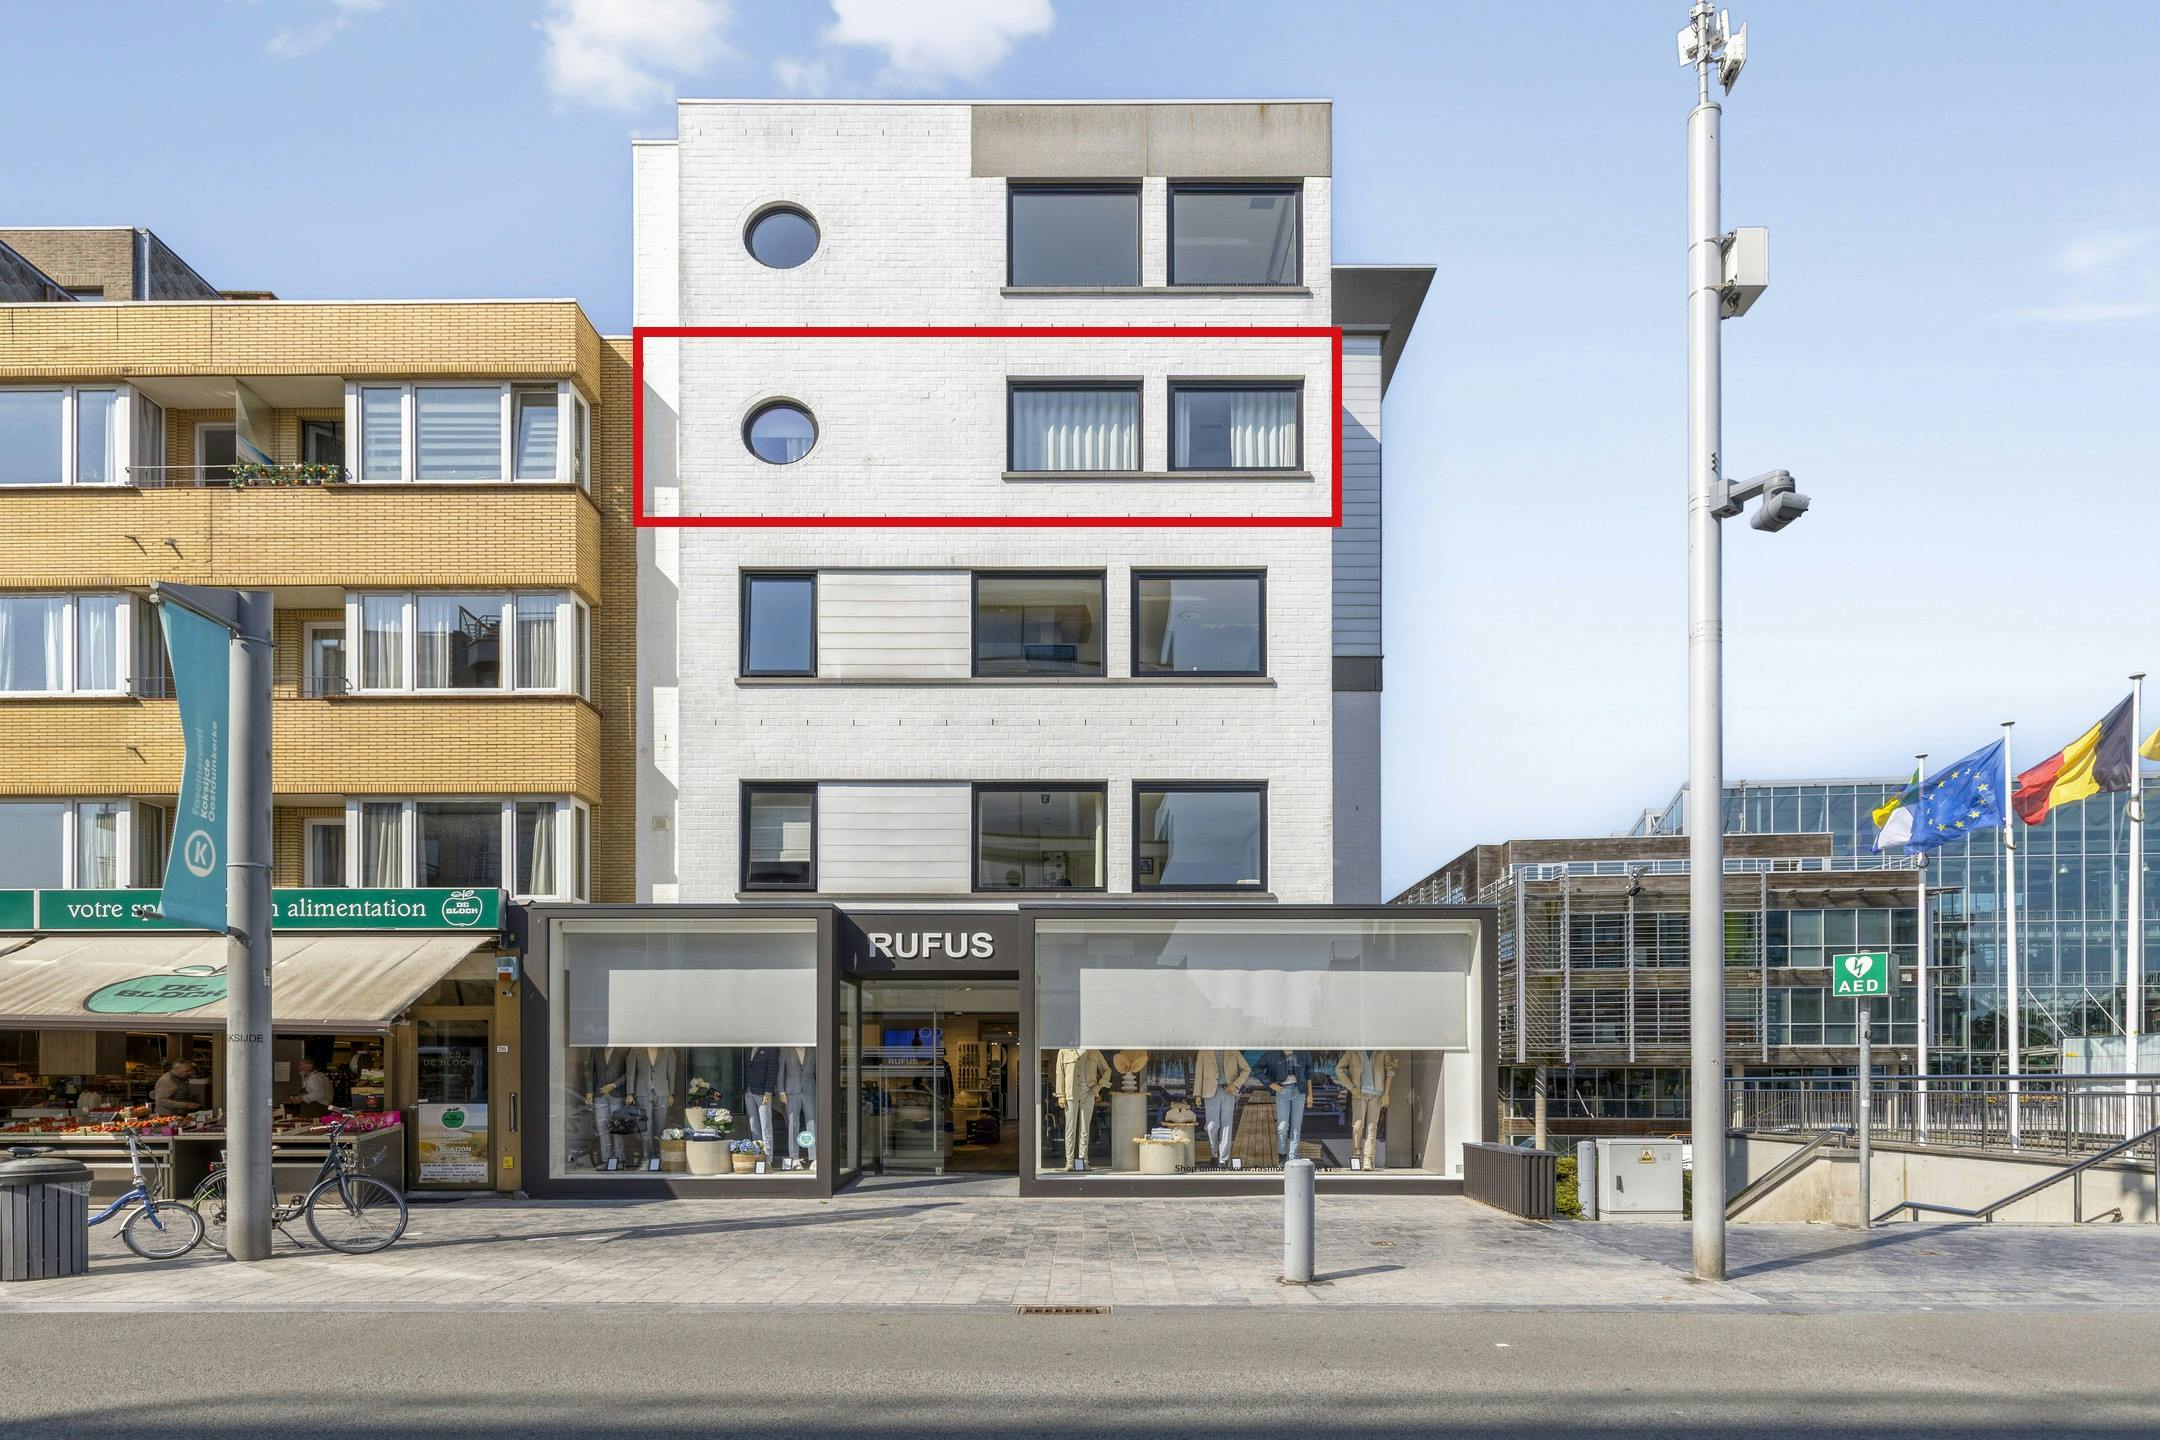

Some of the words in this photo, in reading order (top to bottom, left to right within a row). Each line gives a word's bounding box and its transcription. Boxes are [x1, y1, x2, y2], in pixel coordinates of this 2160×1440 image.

[208, 720, 218, 823] Oostduinkerke
[200, 758, 210, 820] Koksijde
[67, 902, 123, 918] votre
[287, 898, 427, 918] alimentation
[867, 932, 994, 958] RUFUS
[115, 988, 227, 998] BLOCK
[1838, 979, 1879, 993] AED
[888, 1057, 919, 1065] RUFUS
[1174, 1164, 1197, 1174] Shop
[1199, 1164, 1227, 1173] online
